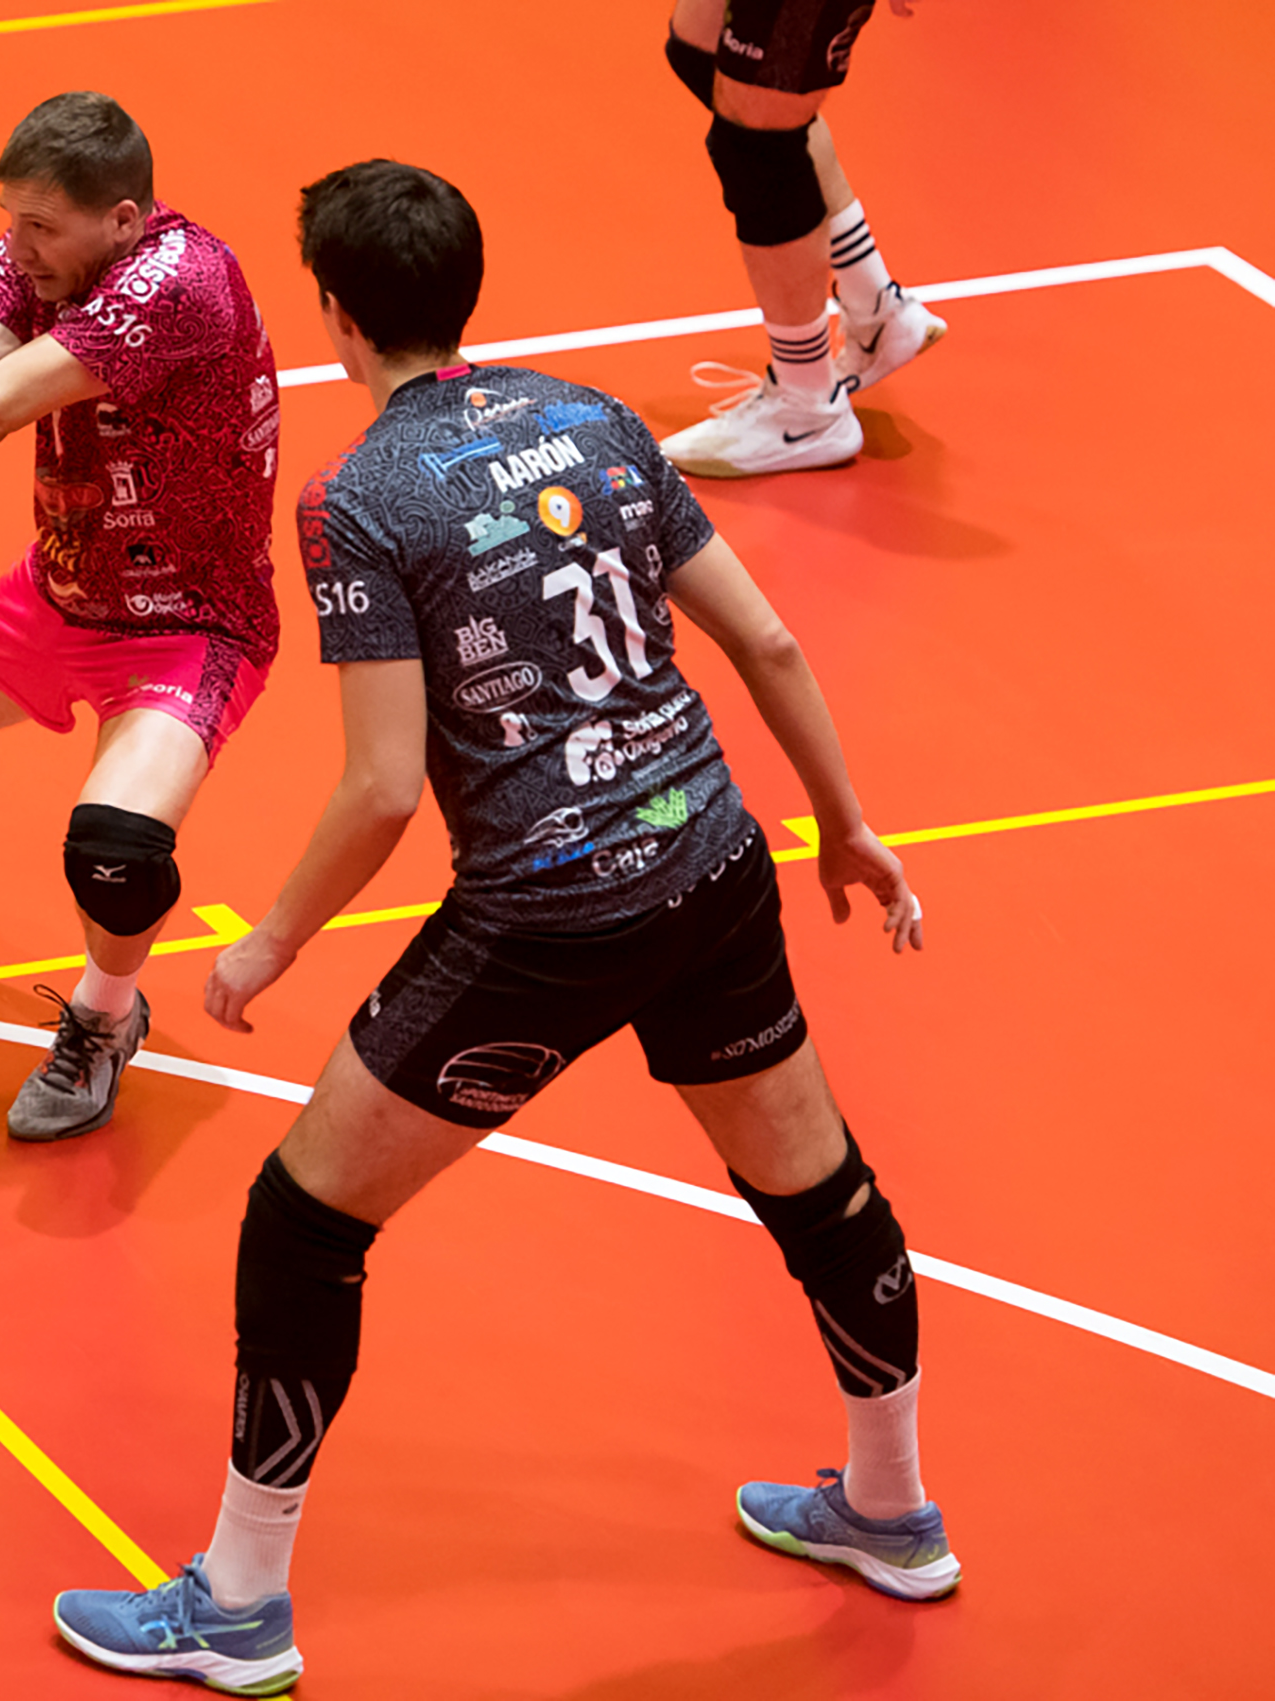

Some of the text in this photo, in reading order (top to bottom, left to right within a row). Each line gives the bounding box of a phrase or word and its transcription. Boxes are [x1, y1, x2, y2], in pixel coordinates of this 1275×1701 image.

[489, 434, 585, 493] AARÓN
[103, 509, 156, 530] Soria
[454, 614, 498, 645] BIG
[542, 547, 654, 702] 31
[456, 630, 508, 662] BEN
[460, 667, 535, 706] SANTIAGO
